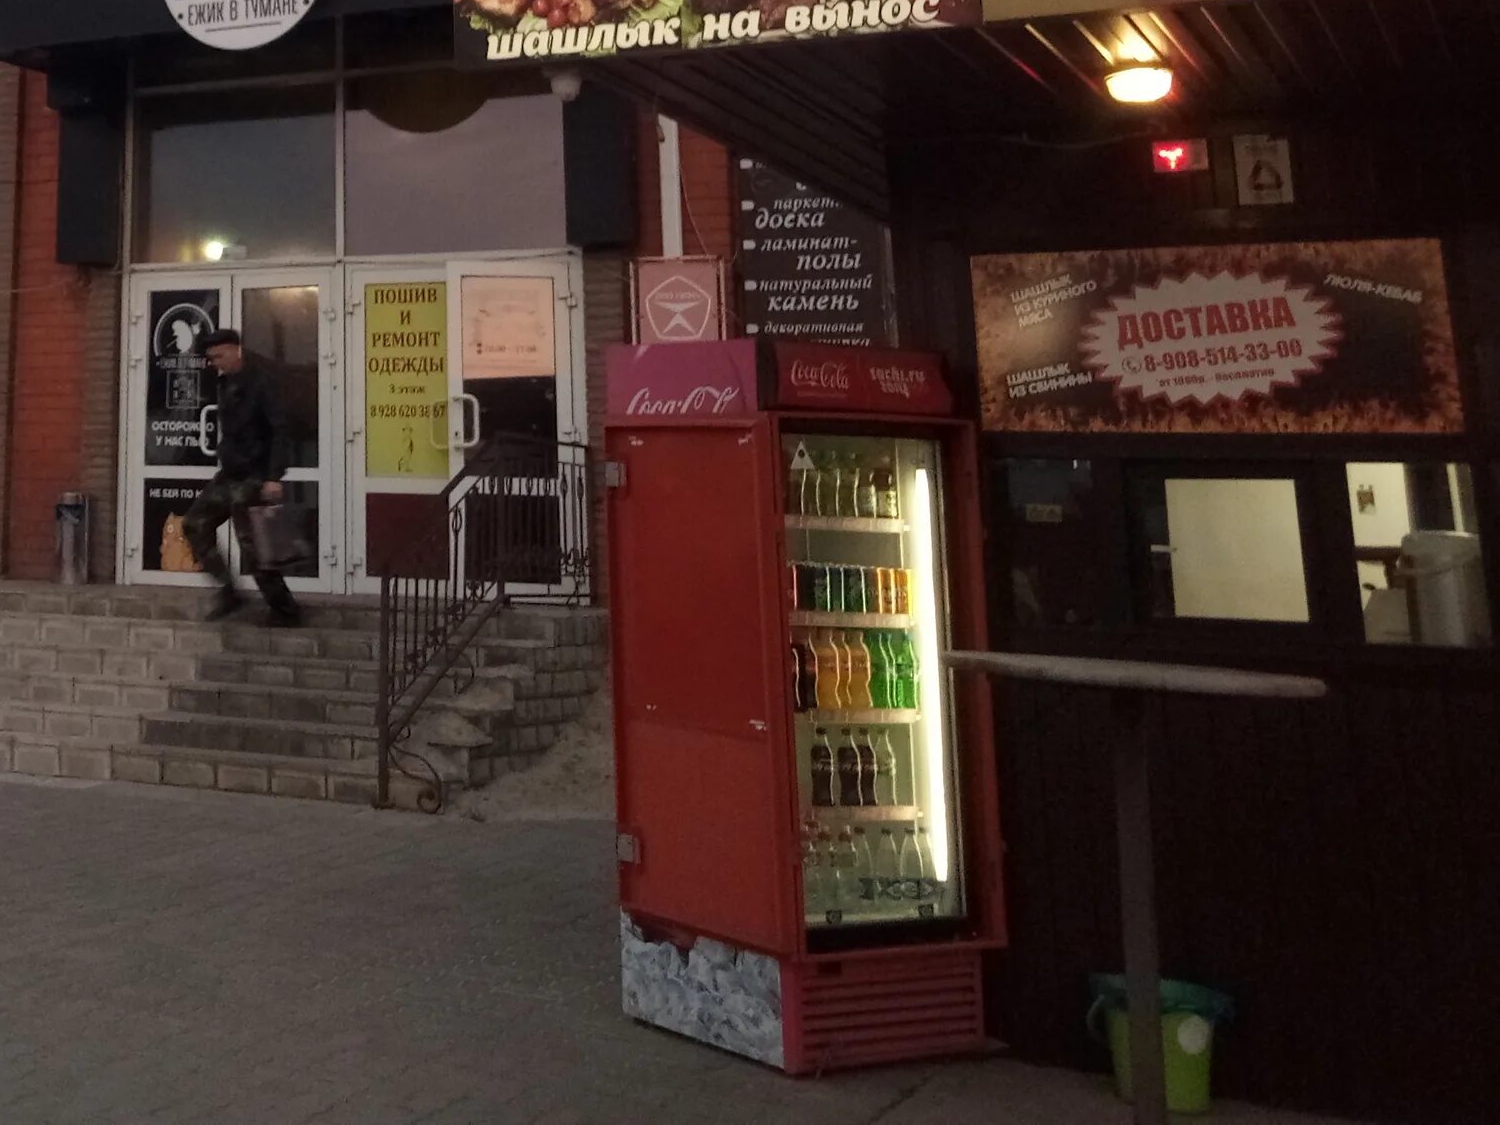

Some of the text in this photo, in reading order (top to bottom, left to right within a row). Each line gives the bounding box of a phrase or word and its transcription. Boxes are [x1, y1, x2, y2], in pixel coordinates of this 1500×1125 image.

[188, 2, 224, 27] ЕЖИК
[229, 2, 238, 22] В
[486, 16, 681, 61] шашлык
[703, 10, 760, 41] на
[755, 208, 824, 229] доска
[796, 251, 861, 270] полы
[759, 274, 873, 293] натуральный
[1011, 274, 1072, 302] ШАШЛЫК
[374, 287, 438, 305] ПОШИВ
[768, 294, 859, 312] камень
[400, 311, 411, 325] И
[1116, 296, 1296, 351] ДОСТАВКА
[764, 321, 864, 336] декоративная
[371, 331, 440, 349] РЕМОНТ
[368, 356, 444, 376] ОДЕЖДЫ
[1006, 362, 1071, 387] ШАШЛЫК
